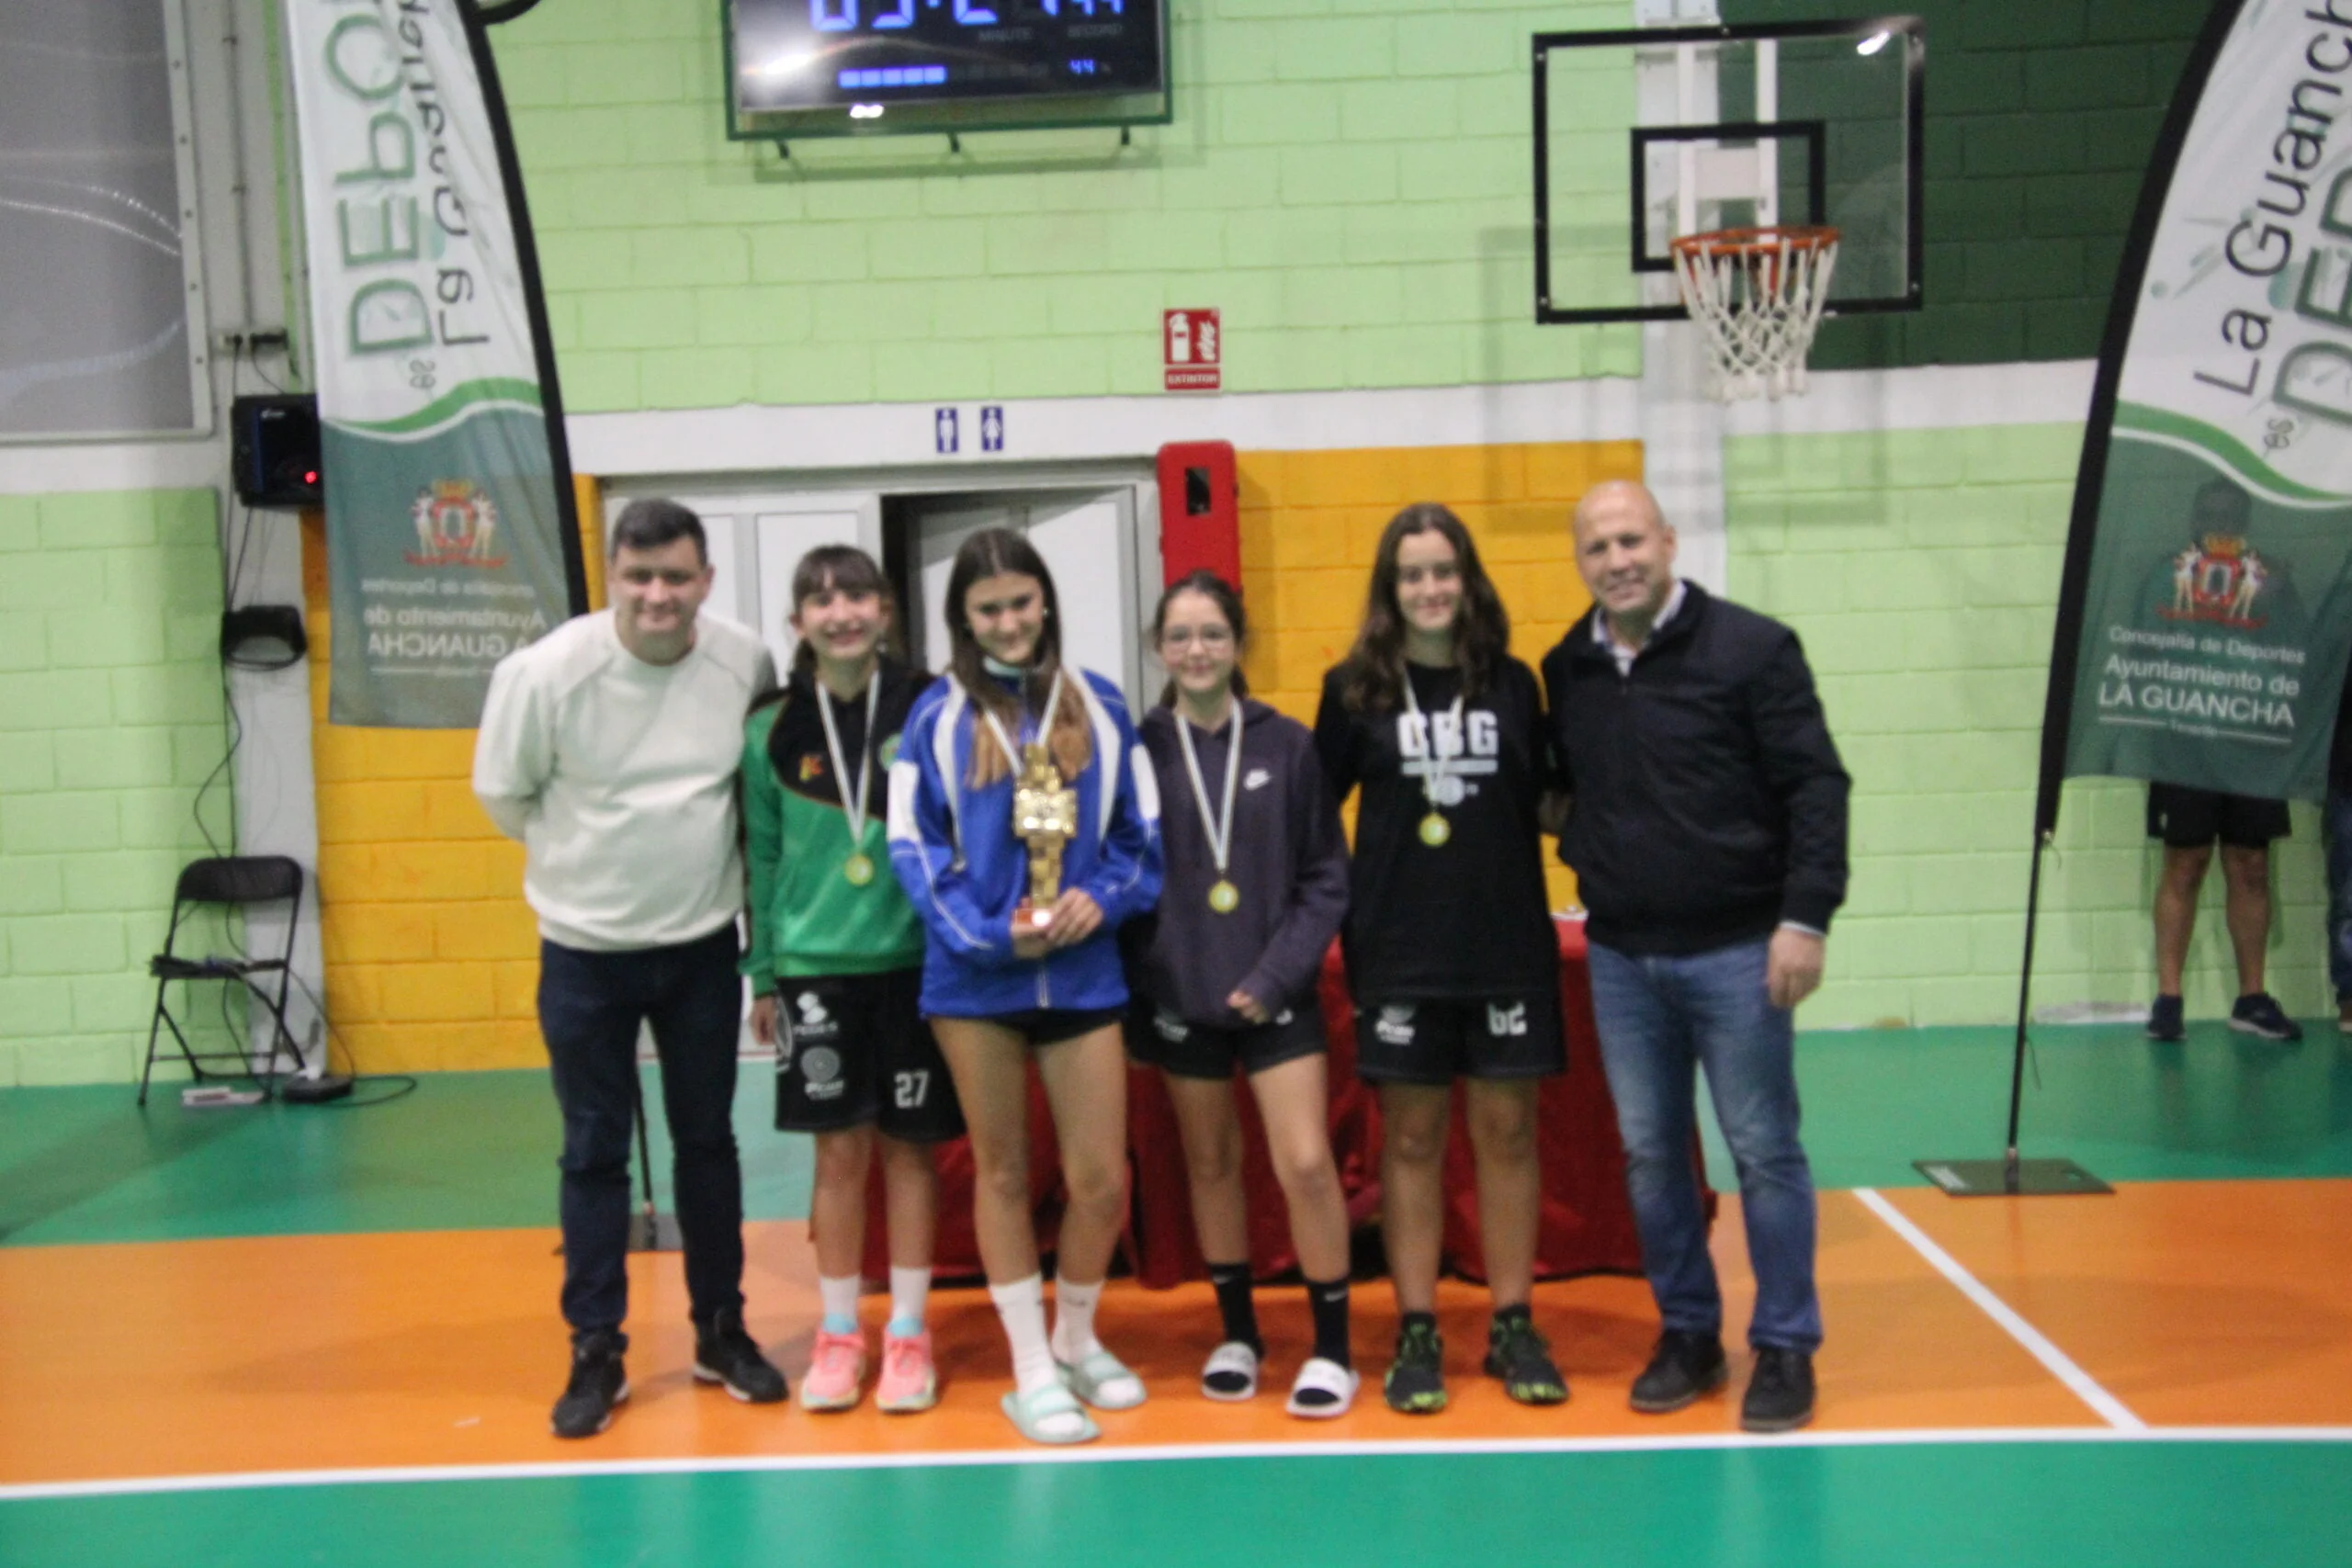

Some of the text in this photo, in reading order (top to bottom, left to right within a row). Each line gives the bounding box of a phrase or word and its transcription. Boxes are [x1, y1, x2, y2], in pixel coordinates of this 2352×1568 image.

[2192, 308, 2272, 397] La
[2199, 637, 2222, 654] de
[2226, 638, 2306, 666] Deportes
[2105, 653, 2301, 696] Ayuntamiento de
[2098, 682, 2296, 728] LA GUANCHA
[894, 1067, 931, 1110] 27
